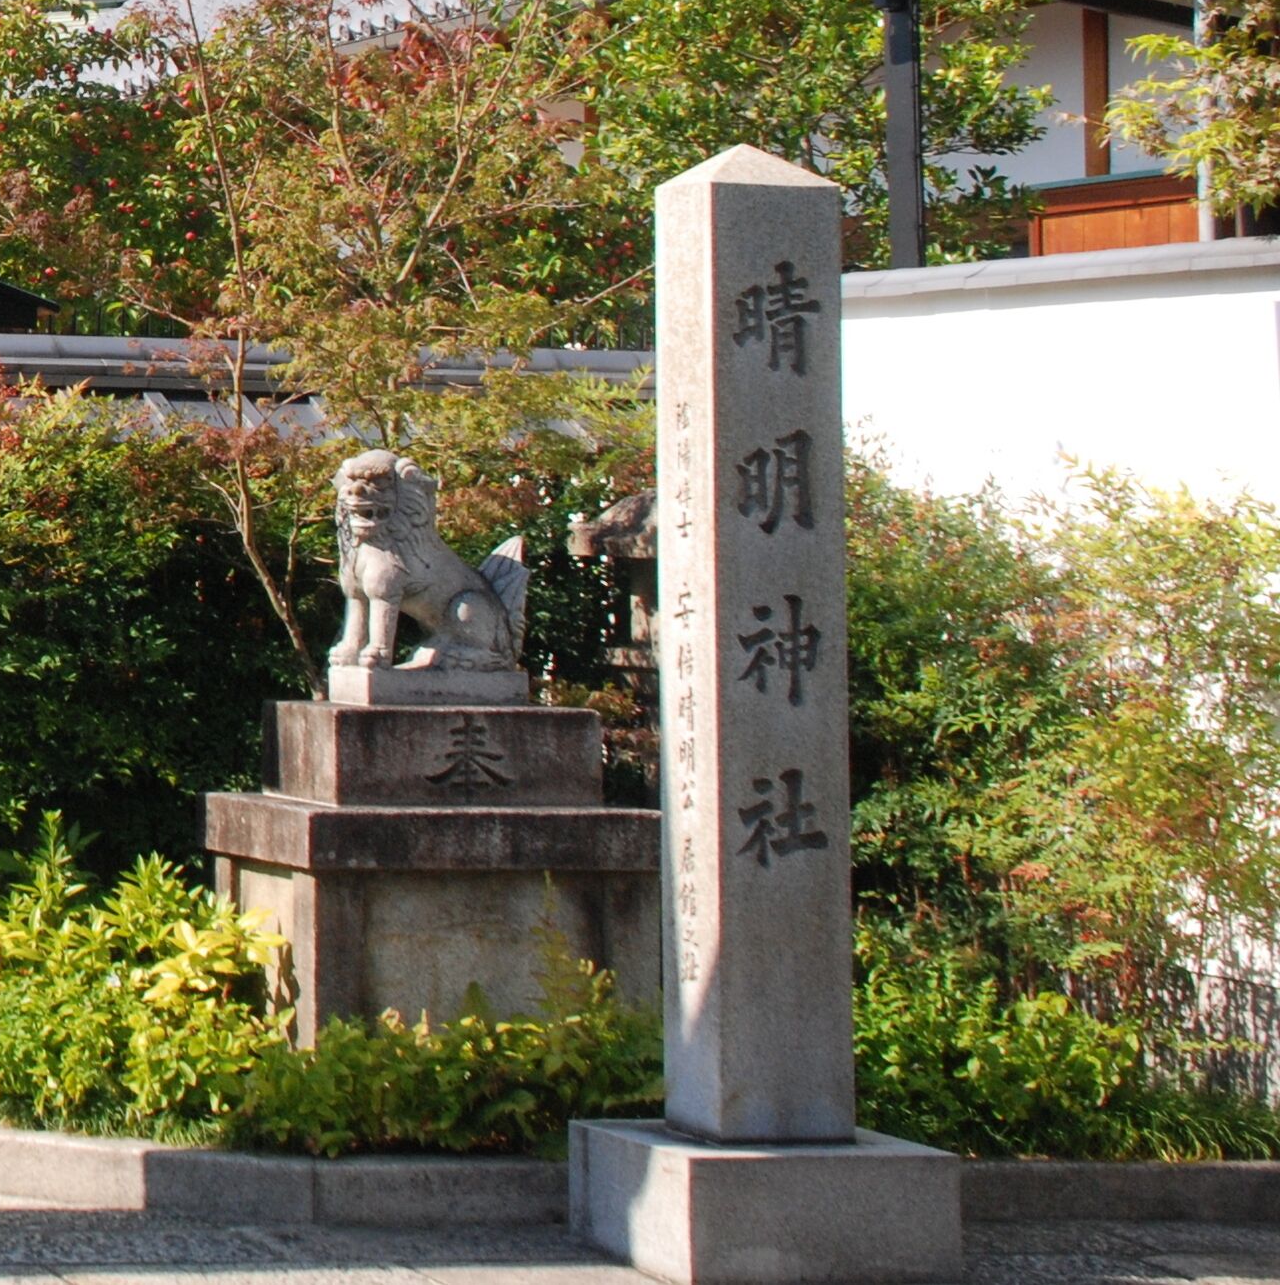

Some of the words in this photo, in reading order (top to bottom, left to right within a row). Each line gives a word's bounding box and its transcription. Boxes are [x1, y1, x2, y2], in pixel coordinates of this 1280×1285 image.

[732, 261, 829, 869] 晴明神社
[424, 713, 514, 805] 奉
